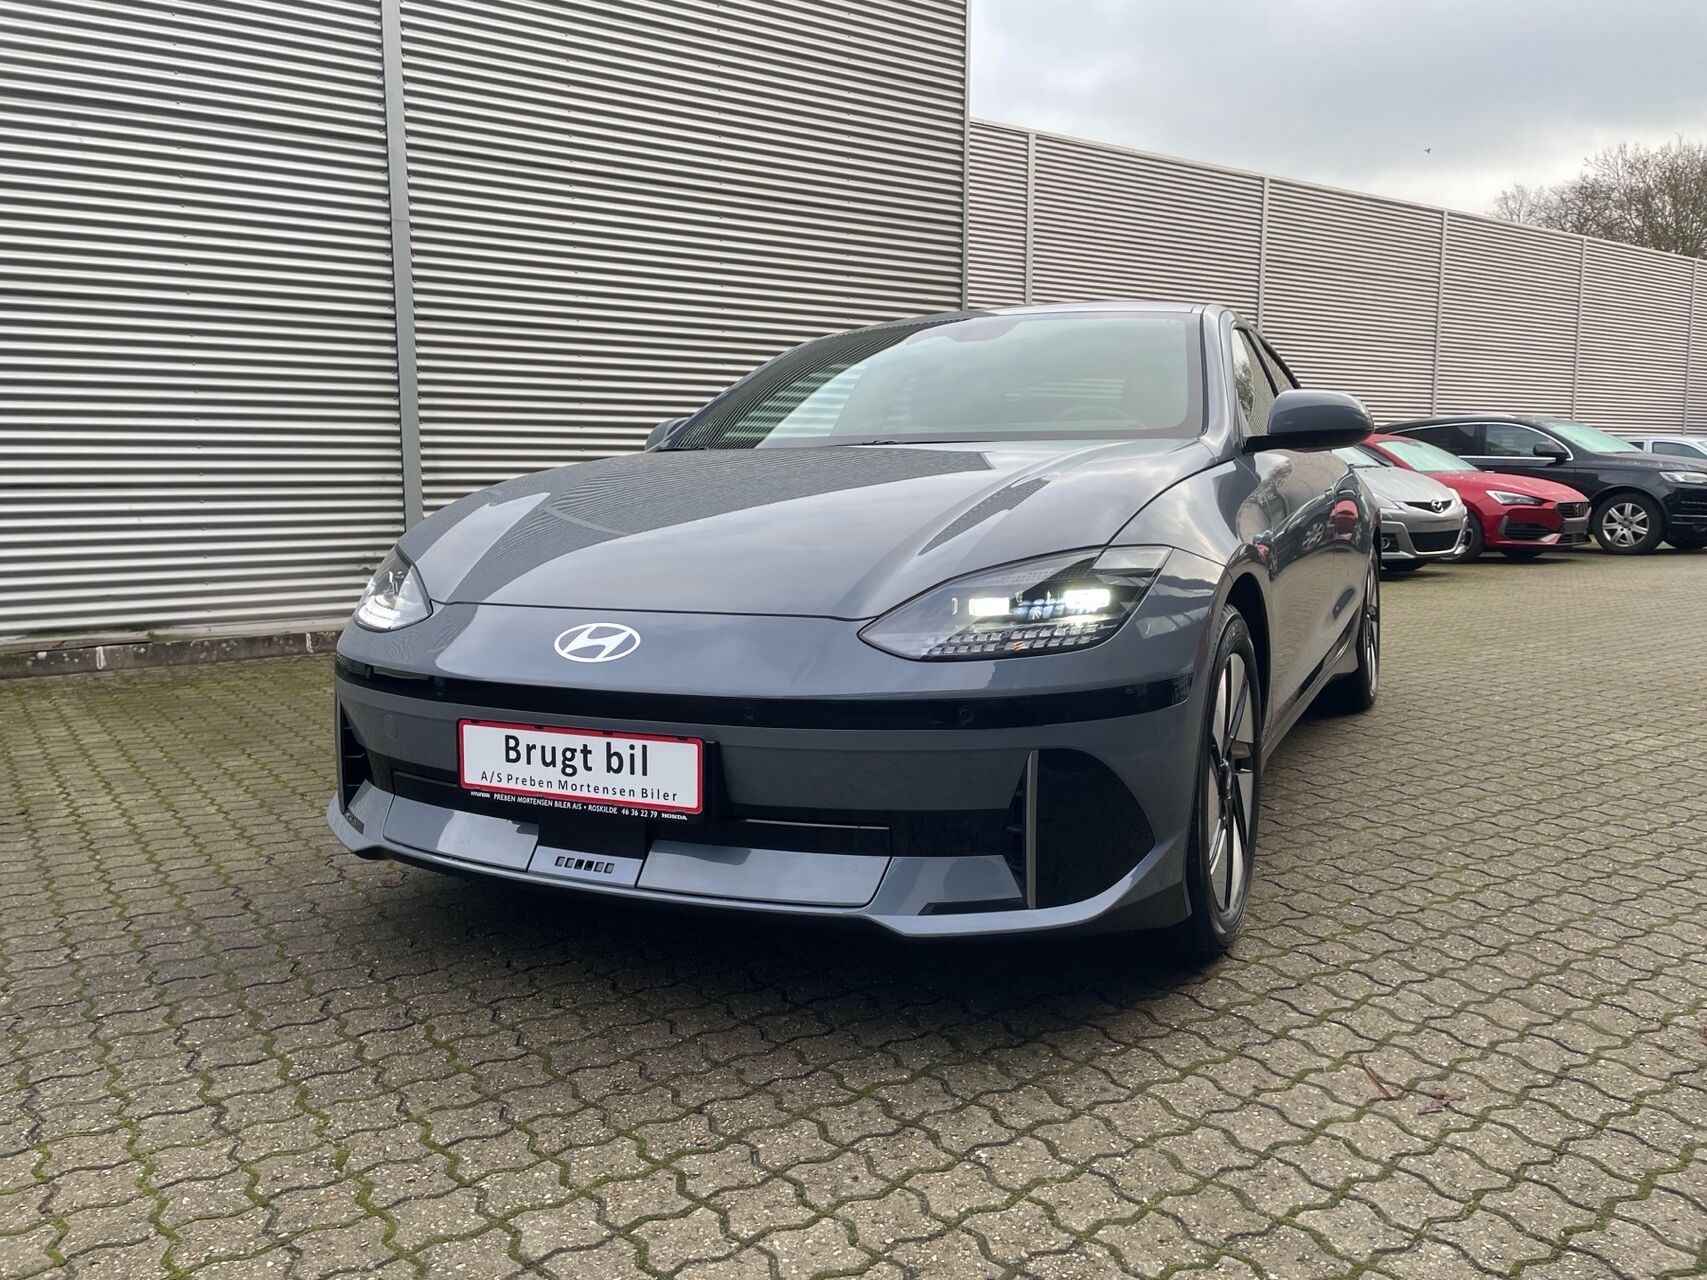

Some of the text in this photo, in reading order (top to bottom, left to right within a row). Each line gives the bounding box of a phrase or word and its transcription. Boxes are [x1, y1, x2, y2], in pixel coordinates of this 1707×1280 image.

[504, 734, 648, 777] Brugt bil
[480, 770, 678, 802] A/S Preben Mortensen Biler
[493, 793, 516, 802] PREBEN
[517, 796, 553, 807] MORTENSEN
[554, 800, 571, 809] BILER
[588, 804, 618, 814] ROSKILDE
[621, 808, 630, 816] 46
[631, 808, 639, 816] 36
[640, 809, 648, 817] 22
[650, 810, 658, 818] 79
